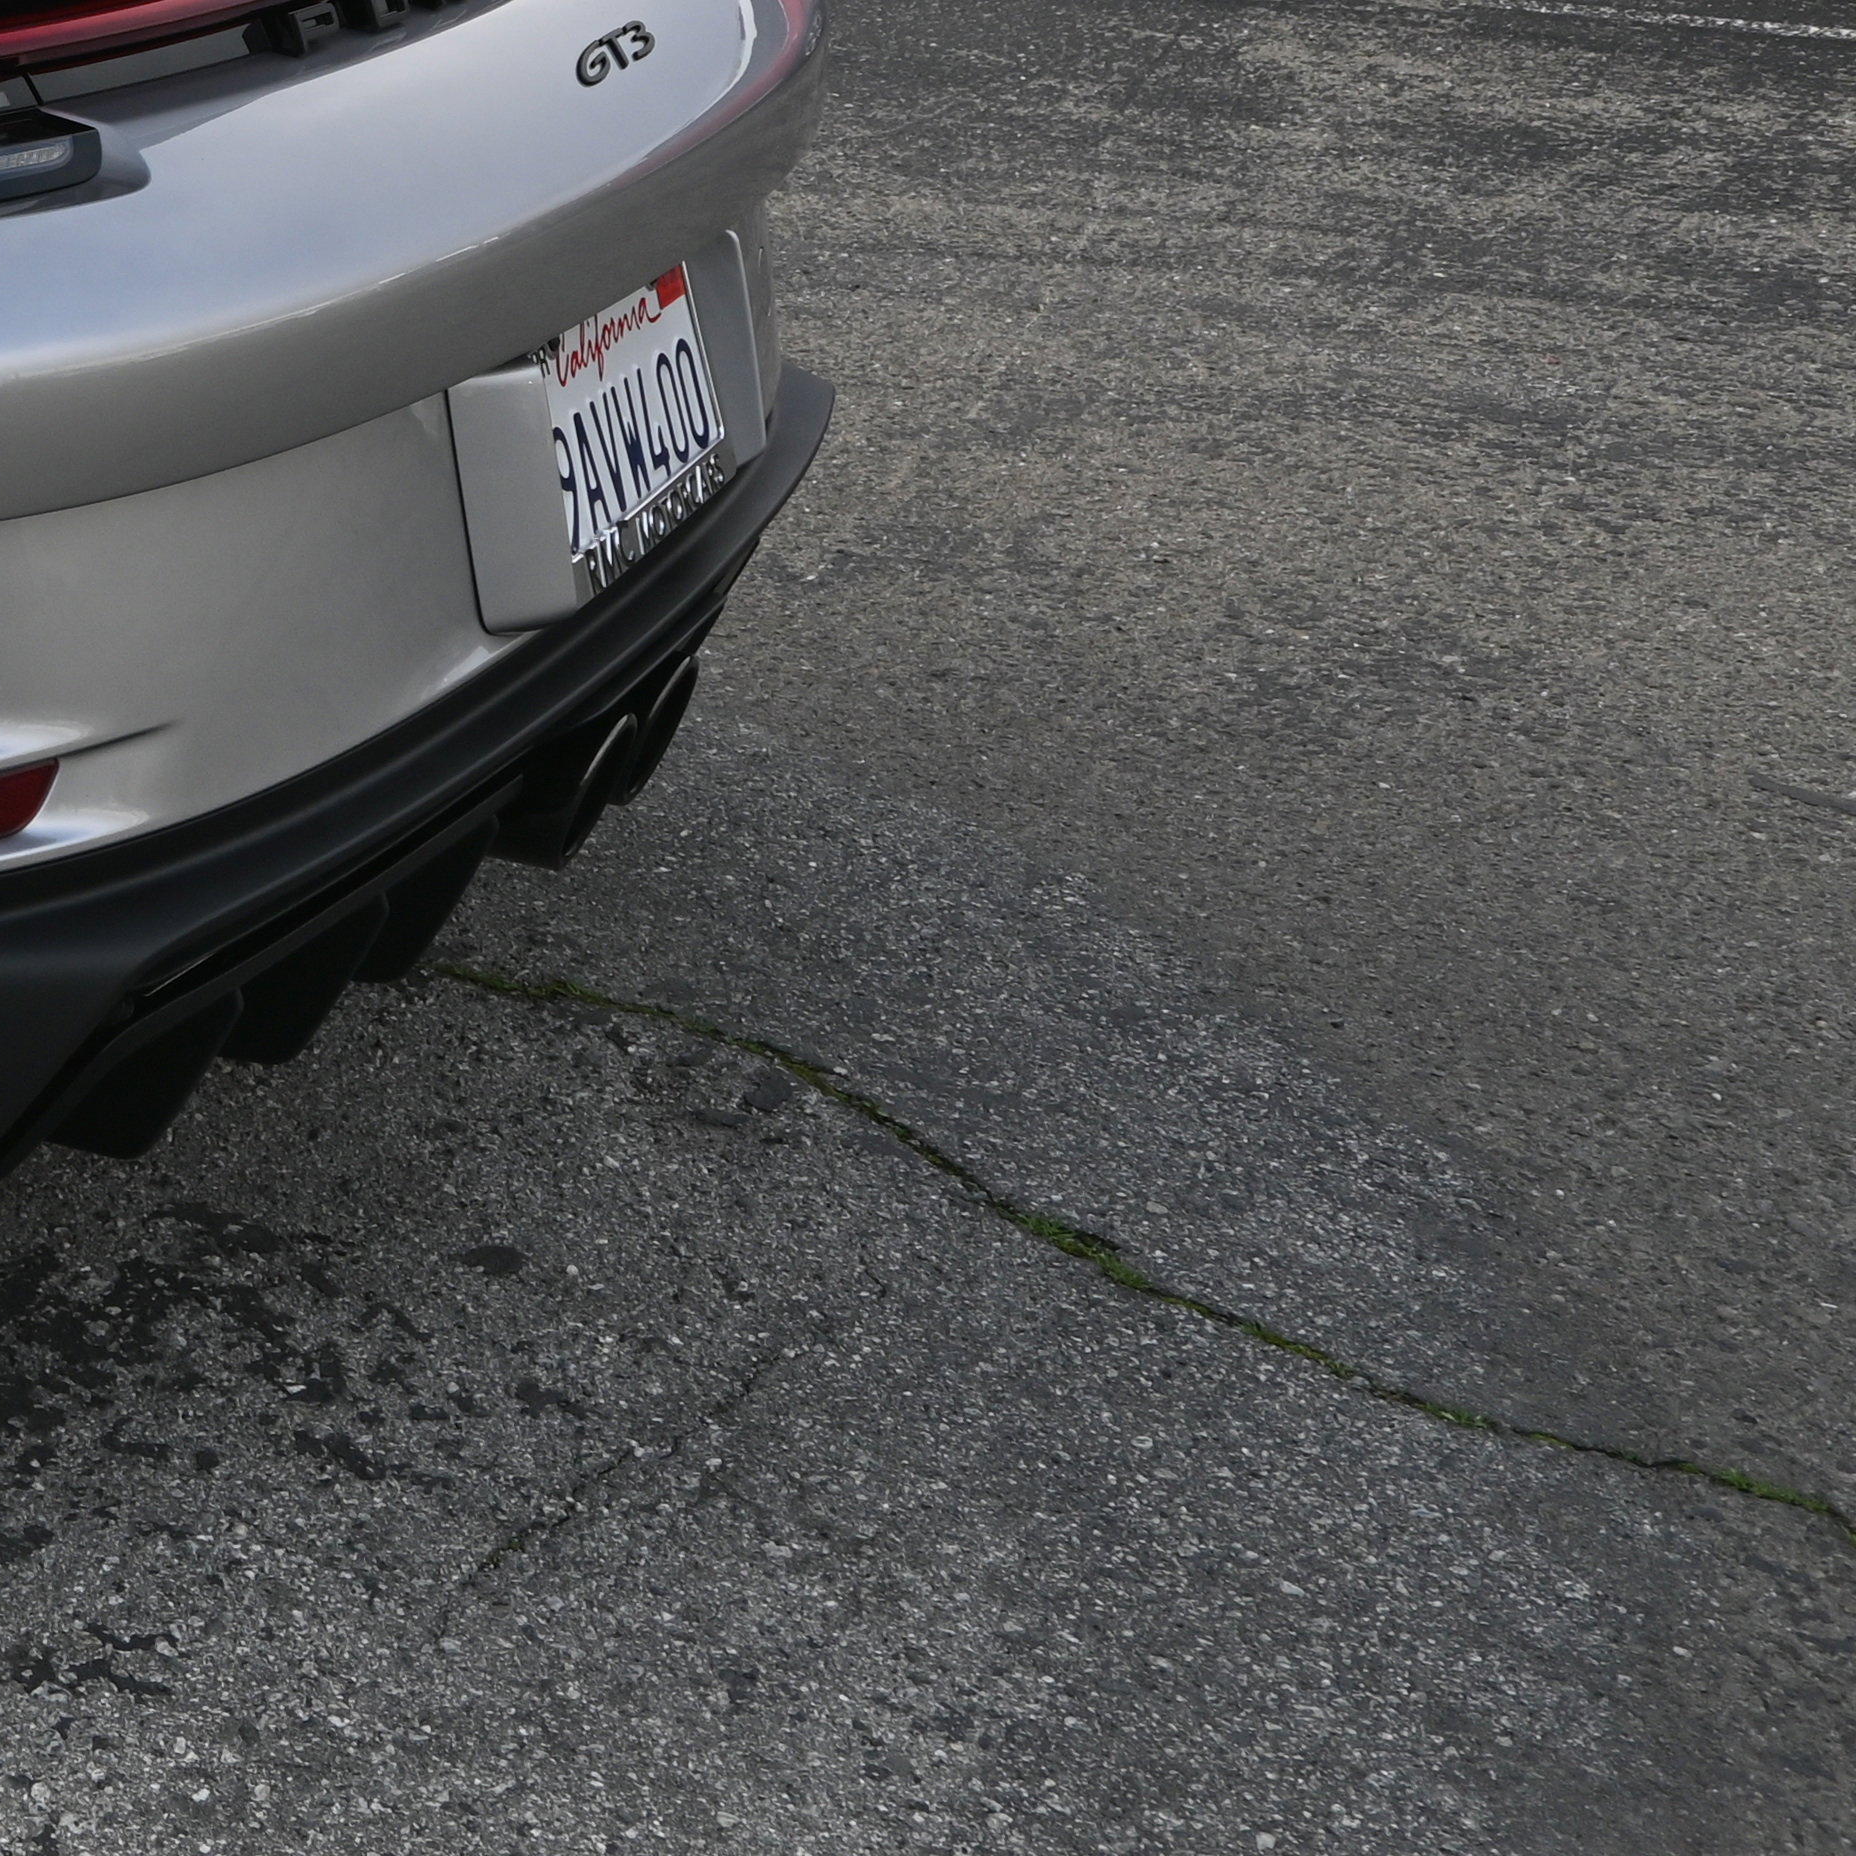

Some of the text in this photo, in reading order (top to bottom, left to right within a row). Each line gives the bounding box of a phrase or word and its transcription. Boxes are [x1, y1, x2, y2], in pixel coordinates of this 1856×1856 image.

[575, 20, 656, 88] GT3
[555, 296, 662, 388] California
[551, 337, 710, 557] 9AVW400
[585, 452, 725, 596] RMC MOTORCARS
